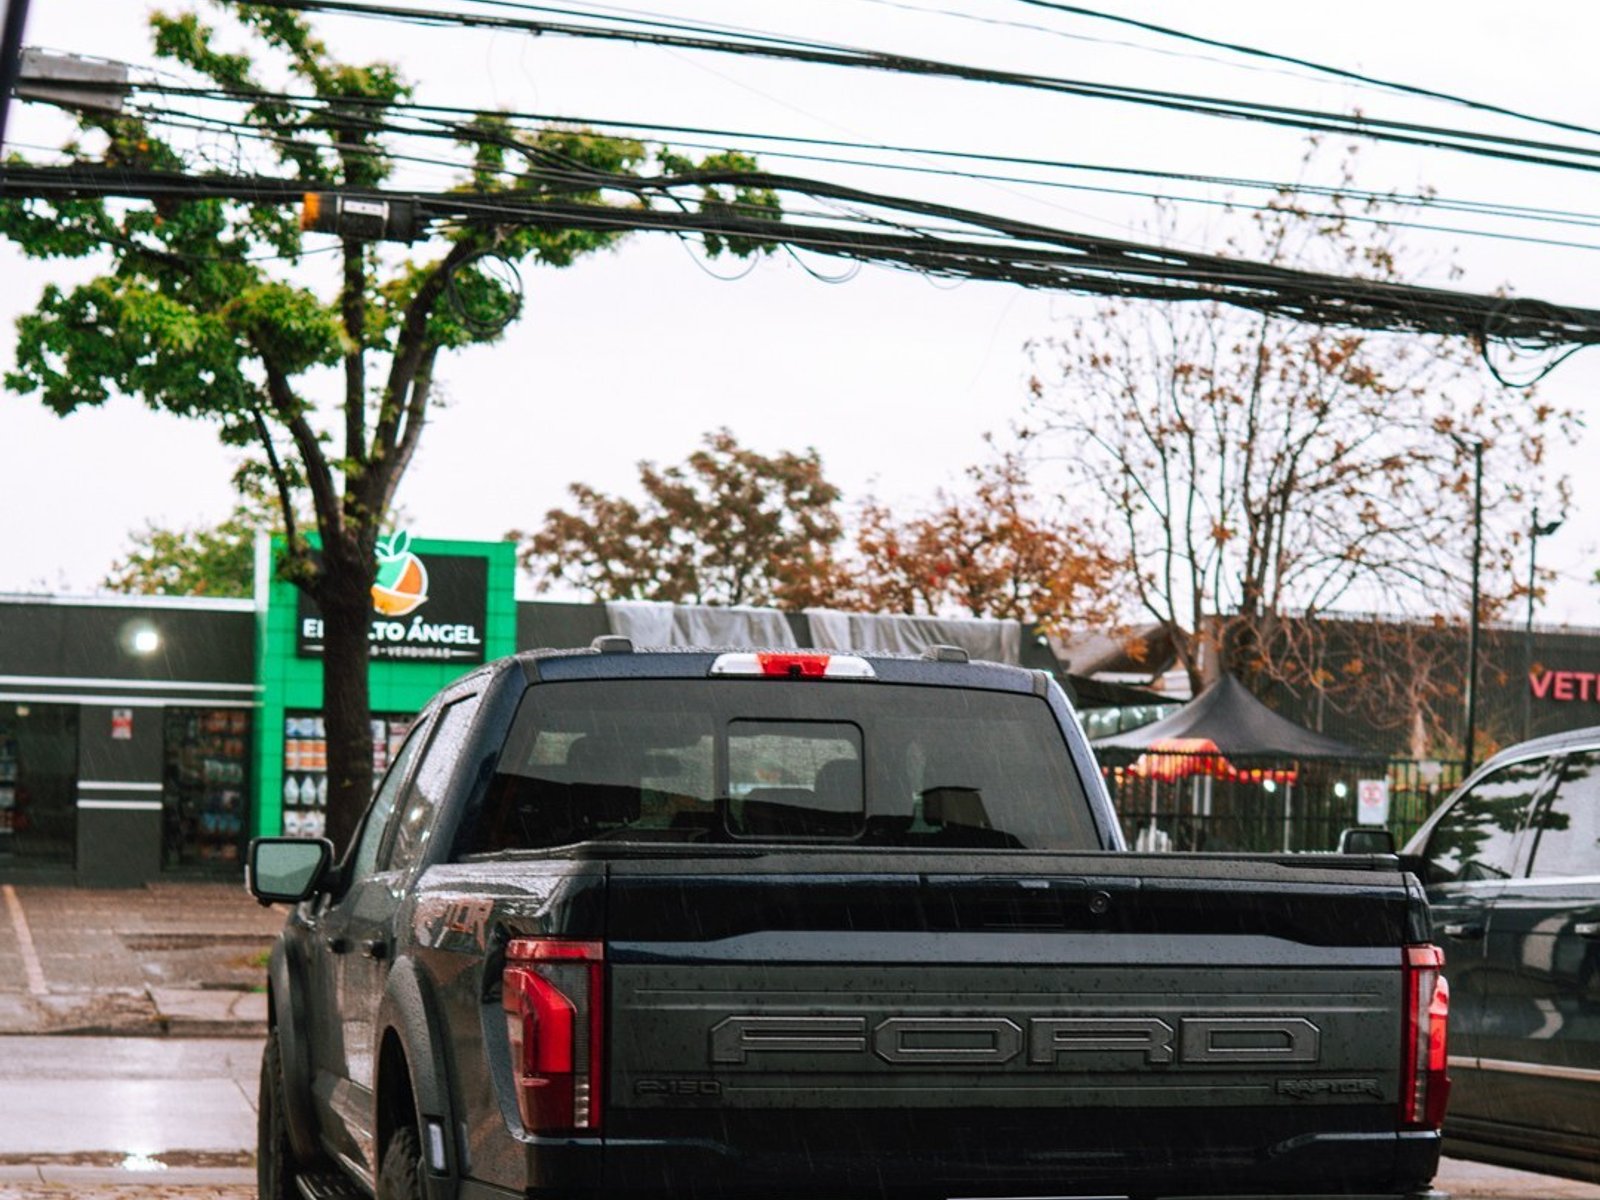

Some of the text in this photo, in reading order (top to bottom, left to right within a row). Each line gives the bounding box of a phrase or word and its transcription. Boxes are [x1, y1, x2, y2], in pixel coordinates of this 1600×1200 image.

[407, 615, 481, 645] ÁNGEL
[709, 1015, 1321, 1065] FORD
[634, 1079, 722, 1096] F-150
[1275, 1077, 1384, 1100] RAPTOR
